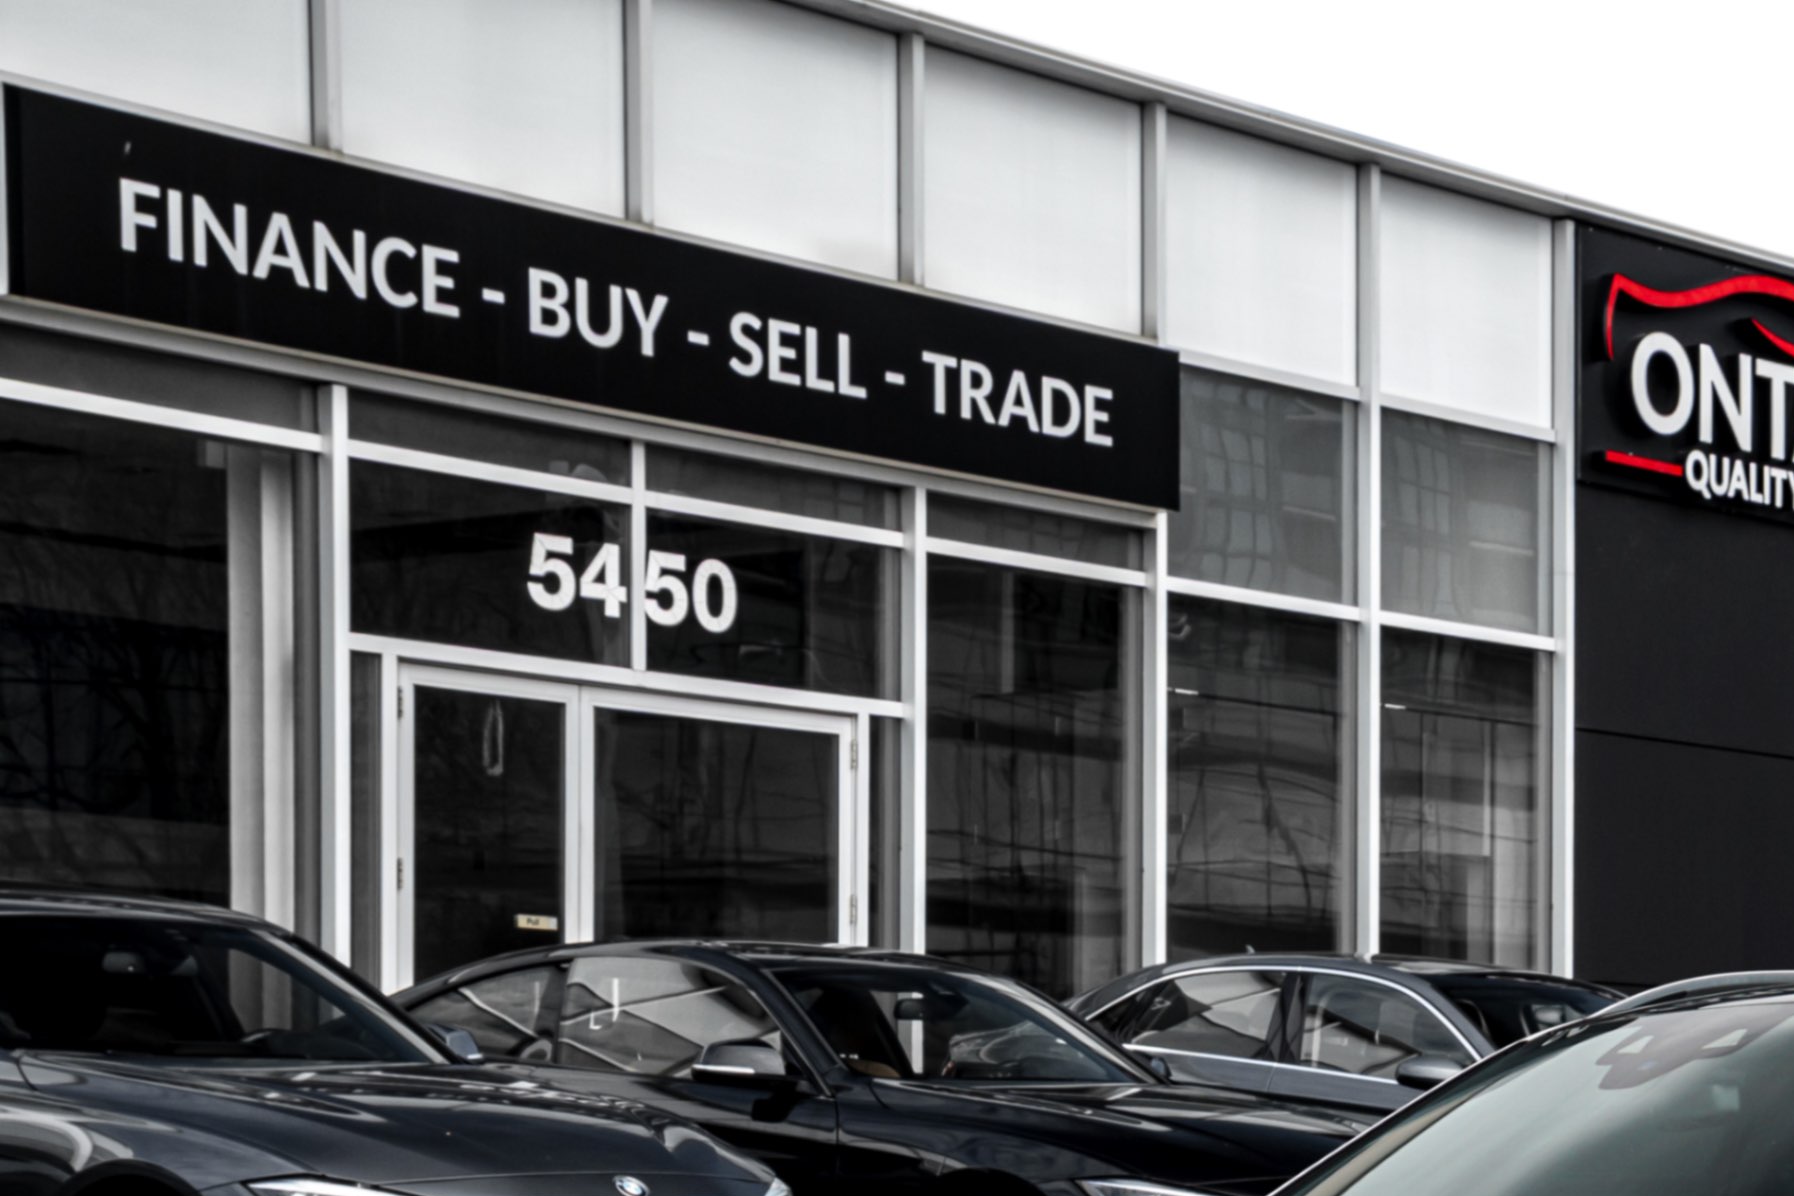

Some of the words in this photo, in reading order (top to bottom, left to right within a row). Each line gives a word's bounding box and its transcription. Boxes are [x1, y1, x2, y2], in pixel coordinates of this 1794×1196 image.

[119, 177, 460, 318] FINANCE
[528, 267, 668, 357] BUY
[729, 312, 867, 399] SELL
[922, 350, 1113, 447] TRADE
[526, 532, 738, 634] 5450
